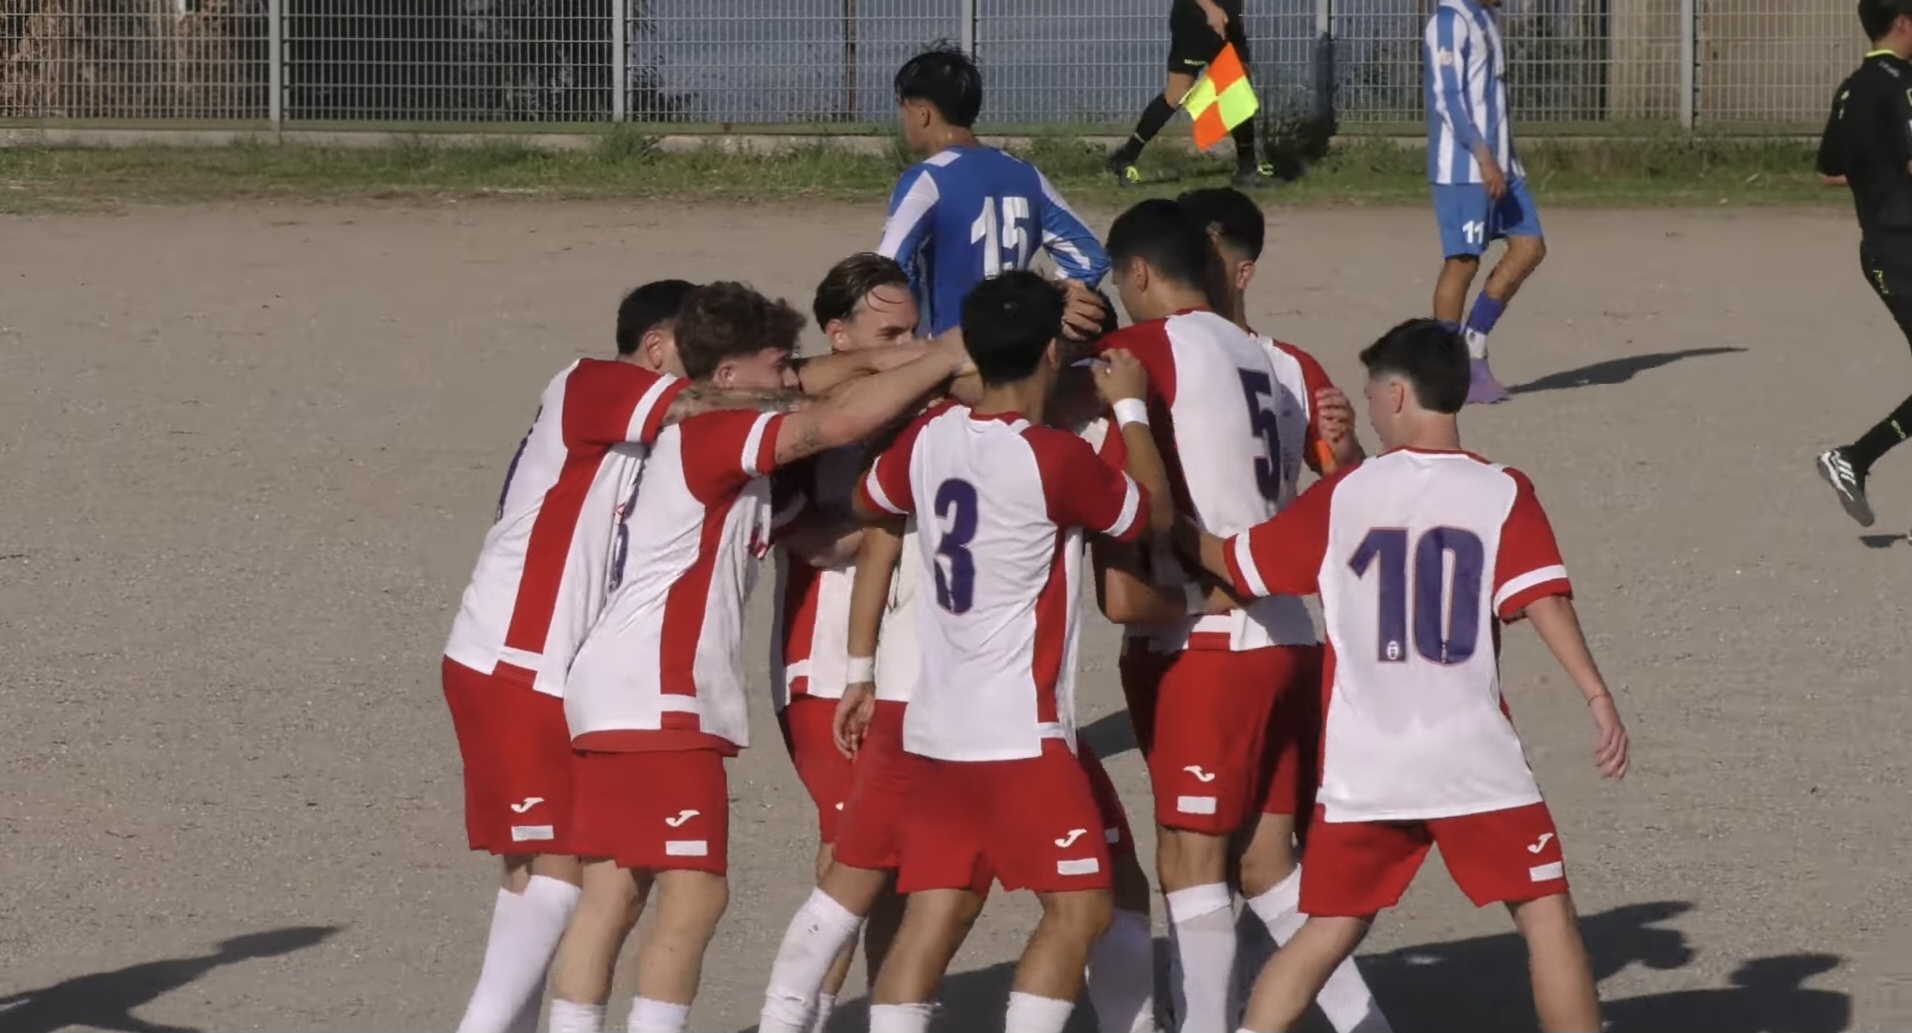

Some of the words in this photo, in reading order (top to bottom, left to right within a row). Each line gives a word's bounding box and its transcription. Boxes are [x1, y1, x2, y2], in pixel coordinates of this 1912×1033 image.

[971, 196, 1029, 280] 15
[1462, 220, 1485, 244] 11
[1237, 367, 1281, 501] 5
[934, 477, 978, 616] 3
[1348, 524, 1484, 667] 10
